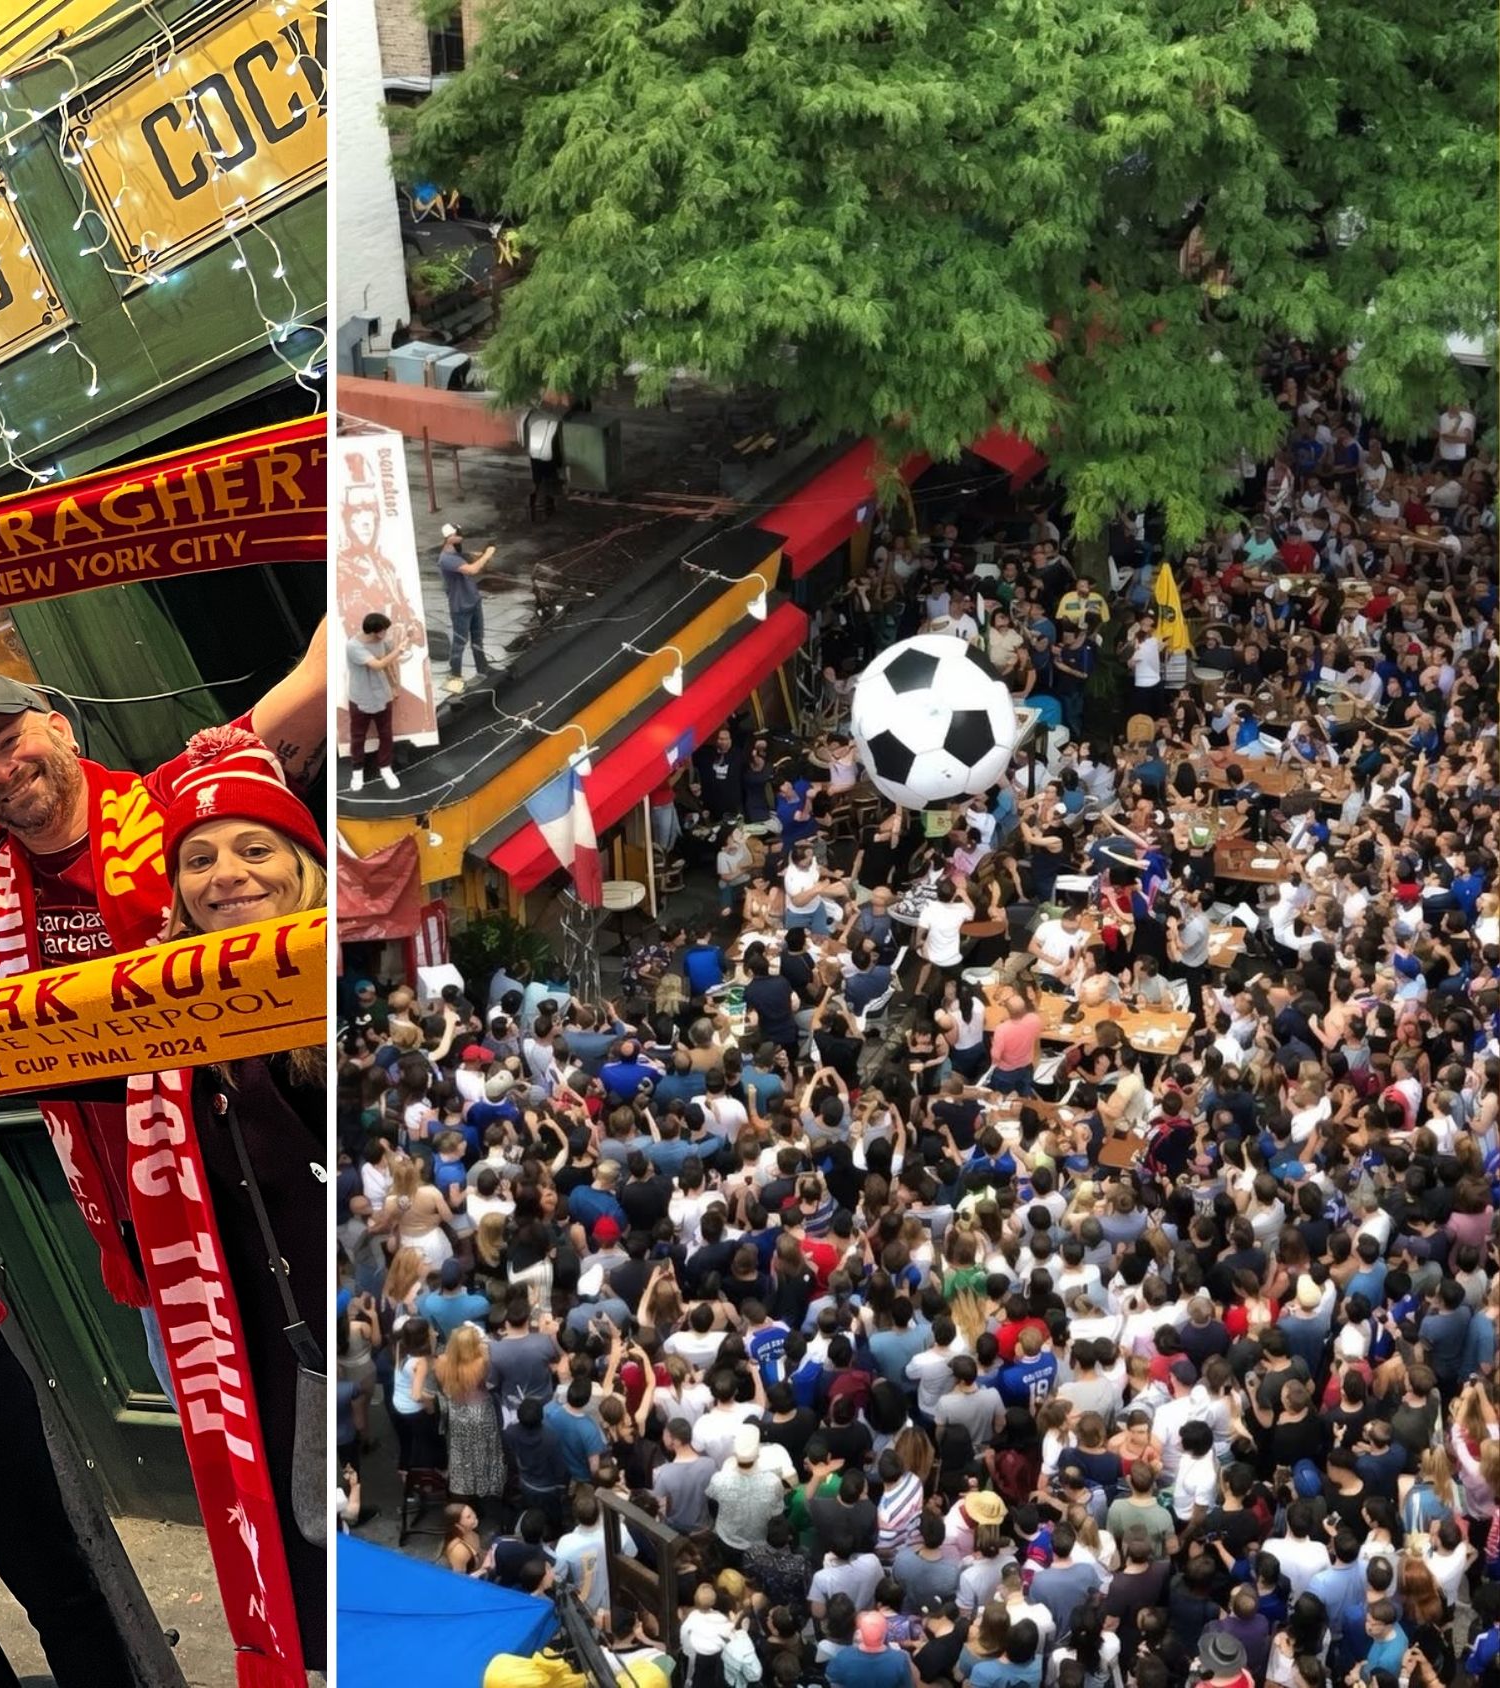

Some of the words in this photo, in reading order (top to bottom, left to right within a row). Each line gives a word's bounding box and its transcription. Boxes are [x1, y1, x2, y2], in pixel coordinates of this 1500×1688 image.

[66, 542, 158, 581] YORK
[169, 530, 247, 566] CITY
[42, 989, 294, 1046] LIVERPOOL
[15, 1055, 59, 1077] CUP
[70, 1044, 137, 1069] FINAL
[146, 1035, 208, 1061] 2024
